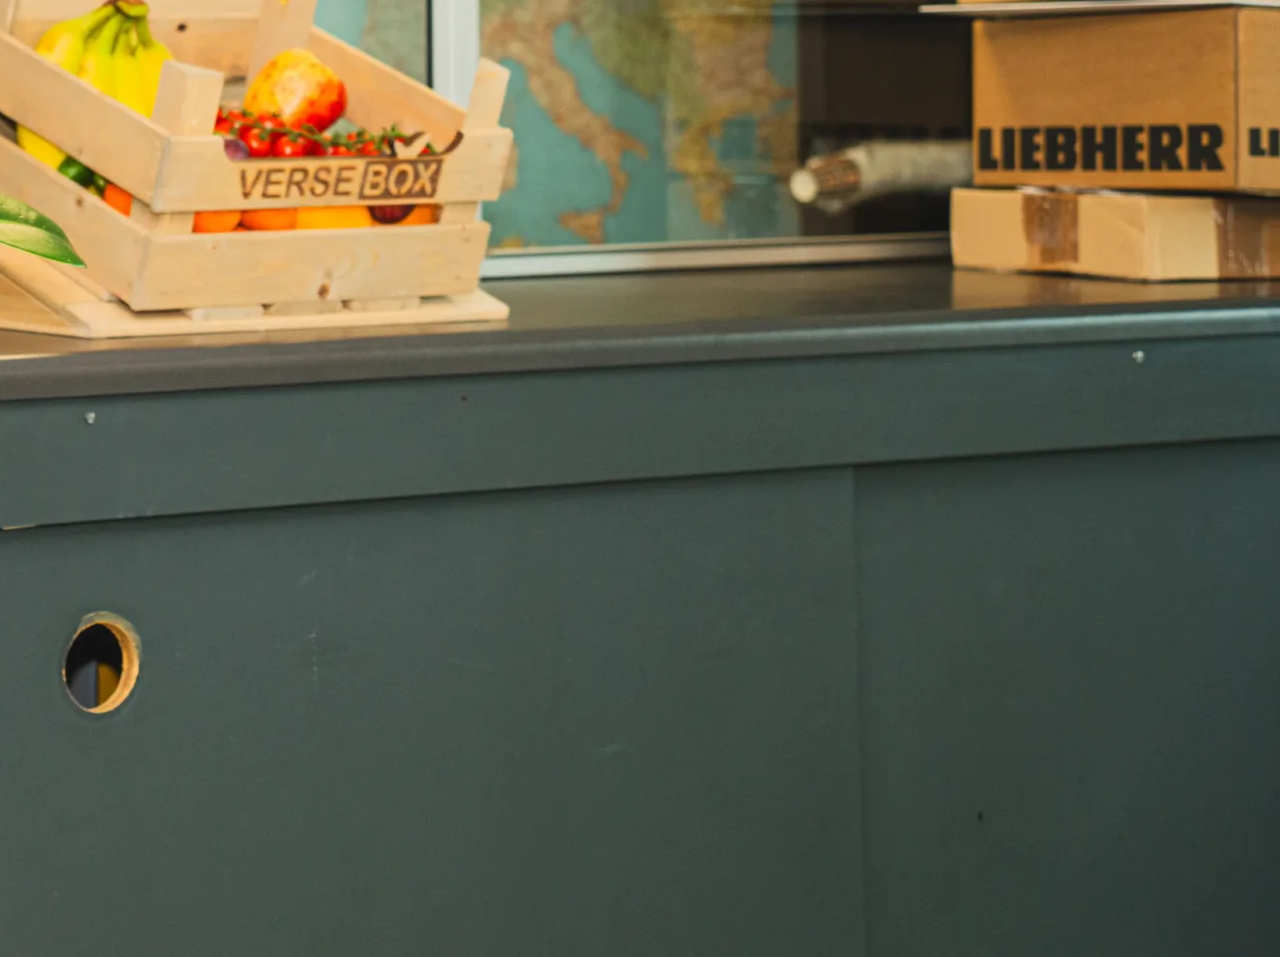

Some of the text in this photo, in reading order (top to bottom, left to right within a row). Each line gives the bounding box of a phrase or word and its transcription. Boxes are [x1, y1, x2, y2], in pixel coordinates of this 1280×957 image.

[978, 124, 1226, 172] LIEBHERR
[239, 161, 439, 200] VERSE BOX
